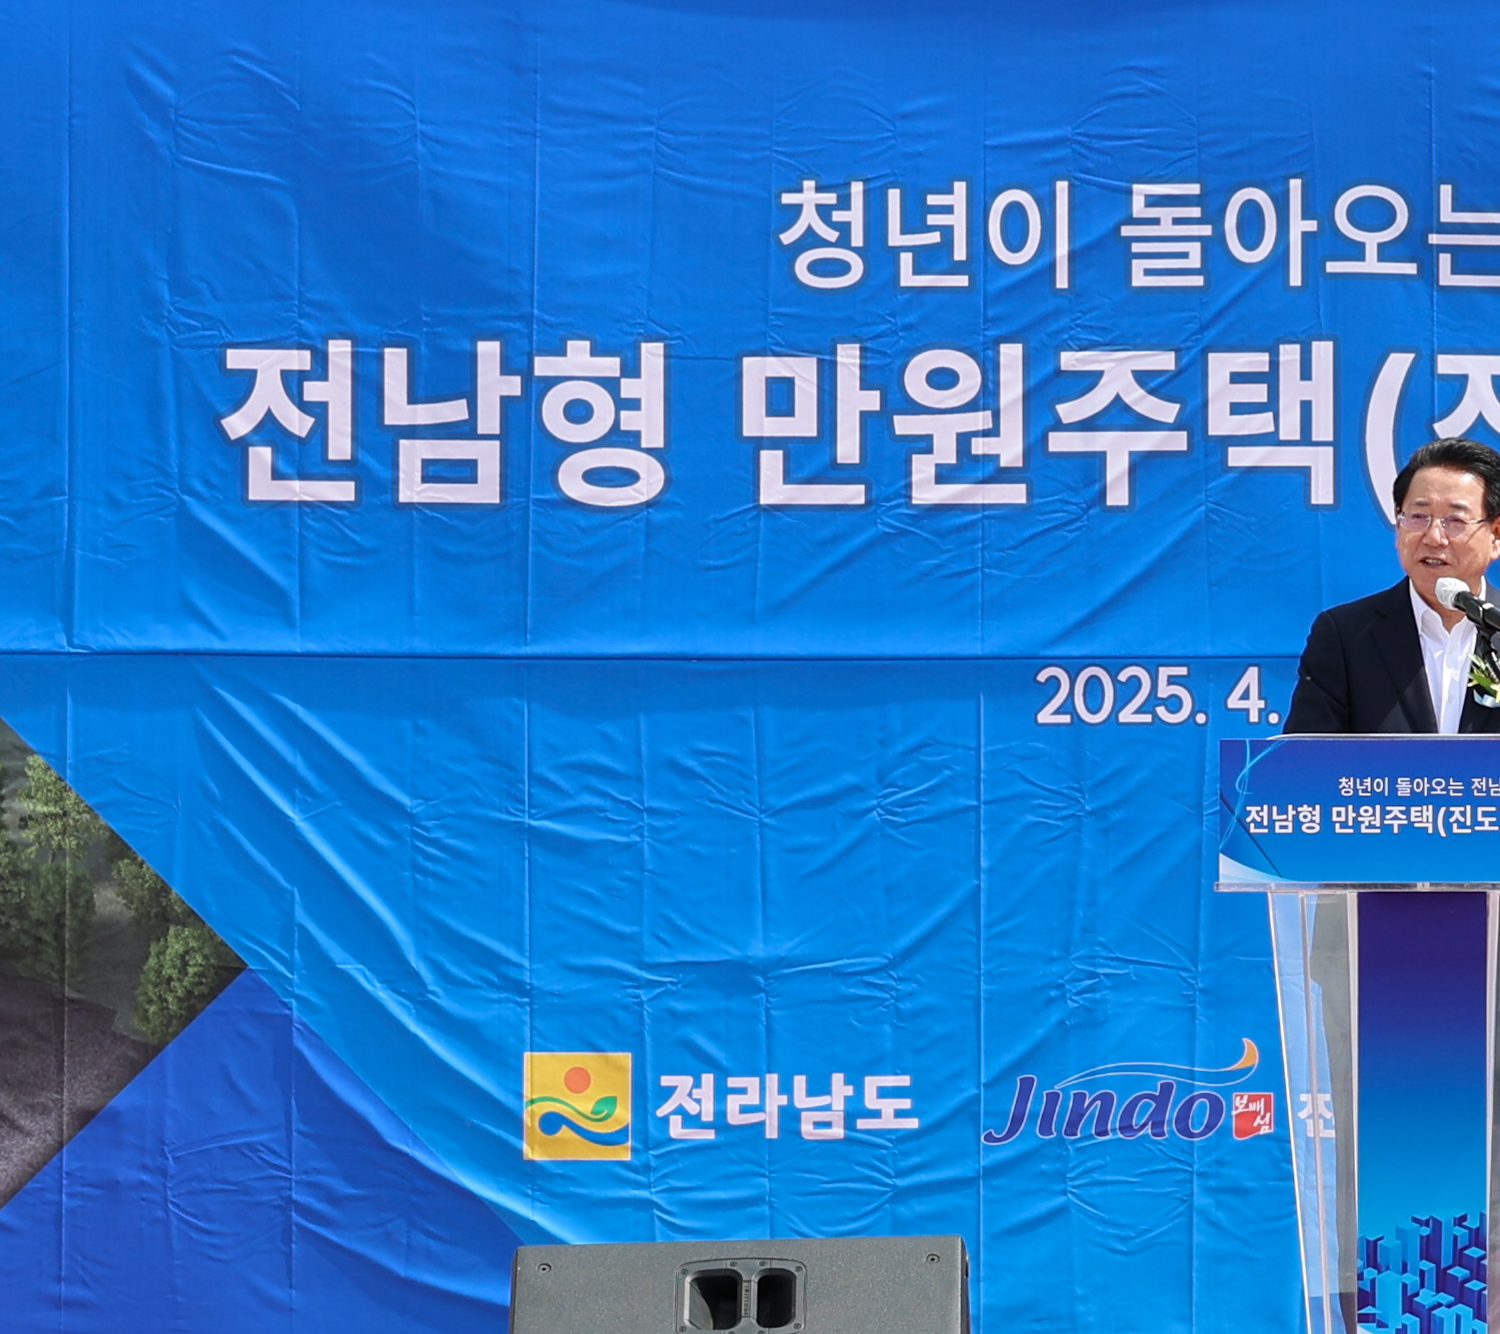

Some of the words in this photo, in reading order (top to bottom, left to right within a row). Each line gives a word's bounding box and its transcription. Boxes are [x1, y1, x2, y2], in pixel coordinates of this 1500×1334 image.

[778, 179, 1070, 290] 청년이
[219, 338, 666, 507] 전남형
[1035, 665, 1208, 725] 2025.
[1226, 665, 1280, 725] 4.
[1245, 803, 1322, 834] 전남형
[1338, 776, 1389, 797] 청년이
[1395, 776, 1465, 797] 돌아오는
[654, 1071, 920, 1140] 전라남도
[982, 1074, 1225, 1145] Jindo
